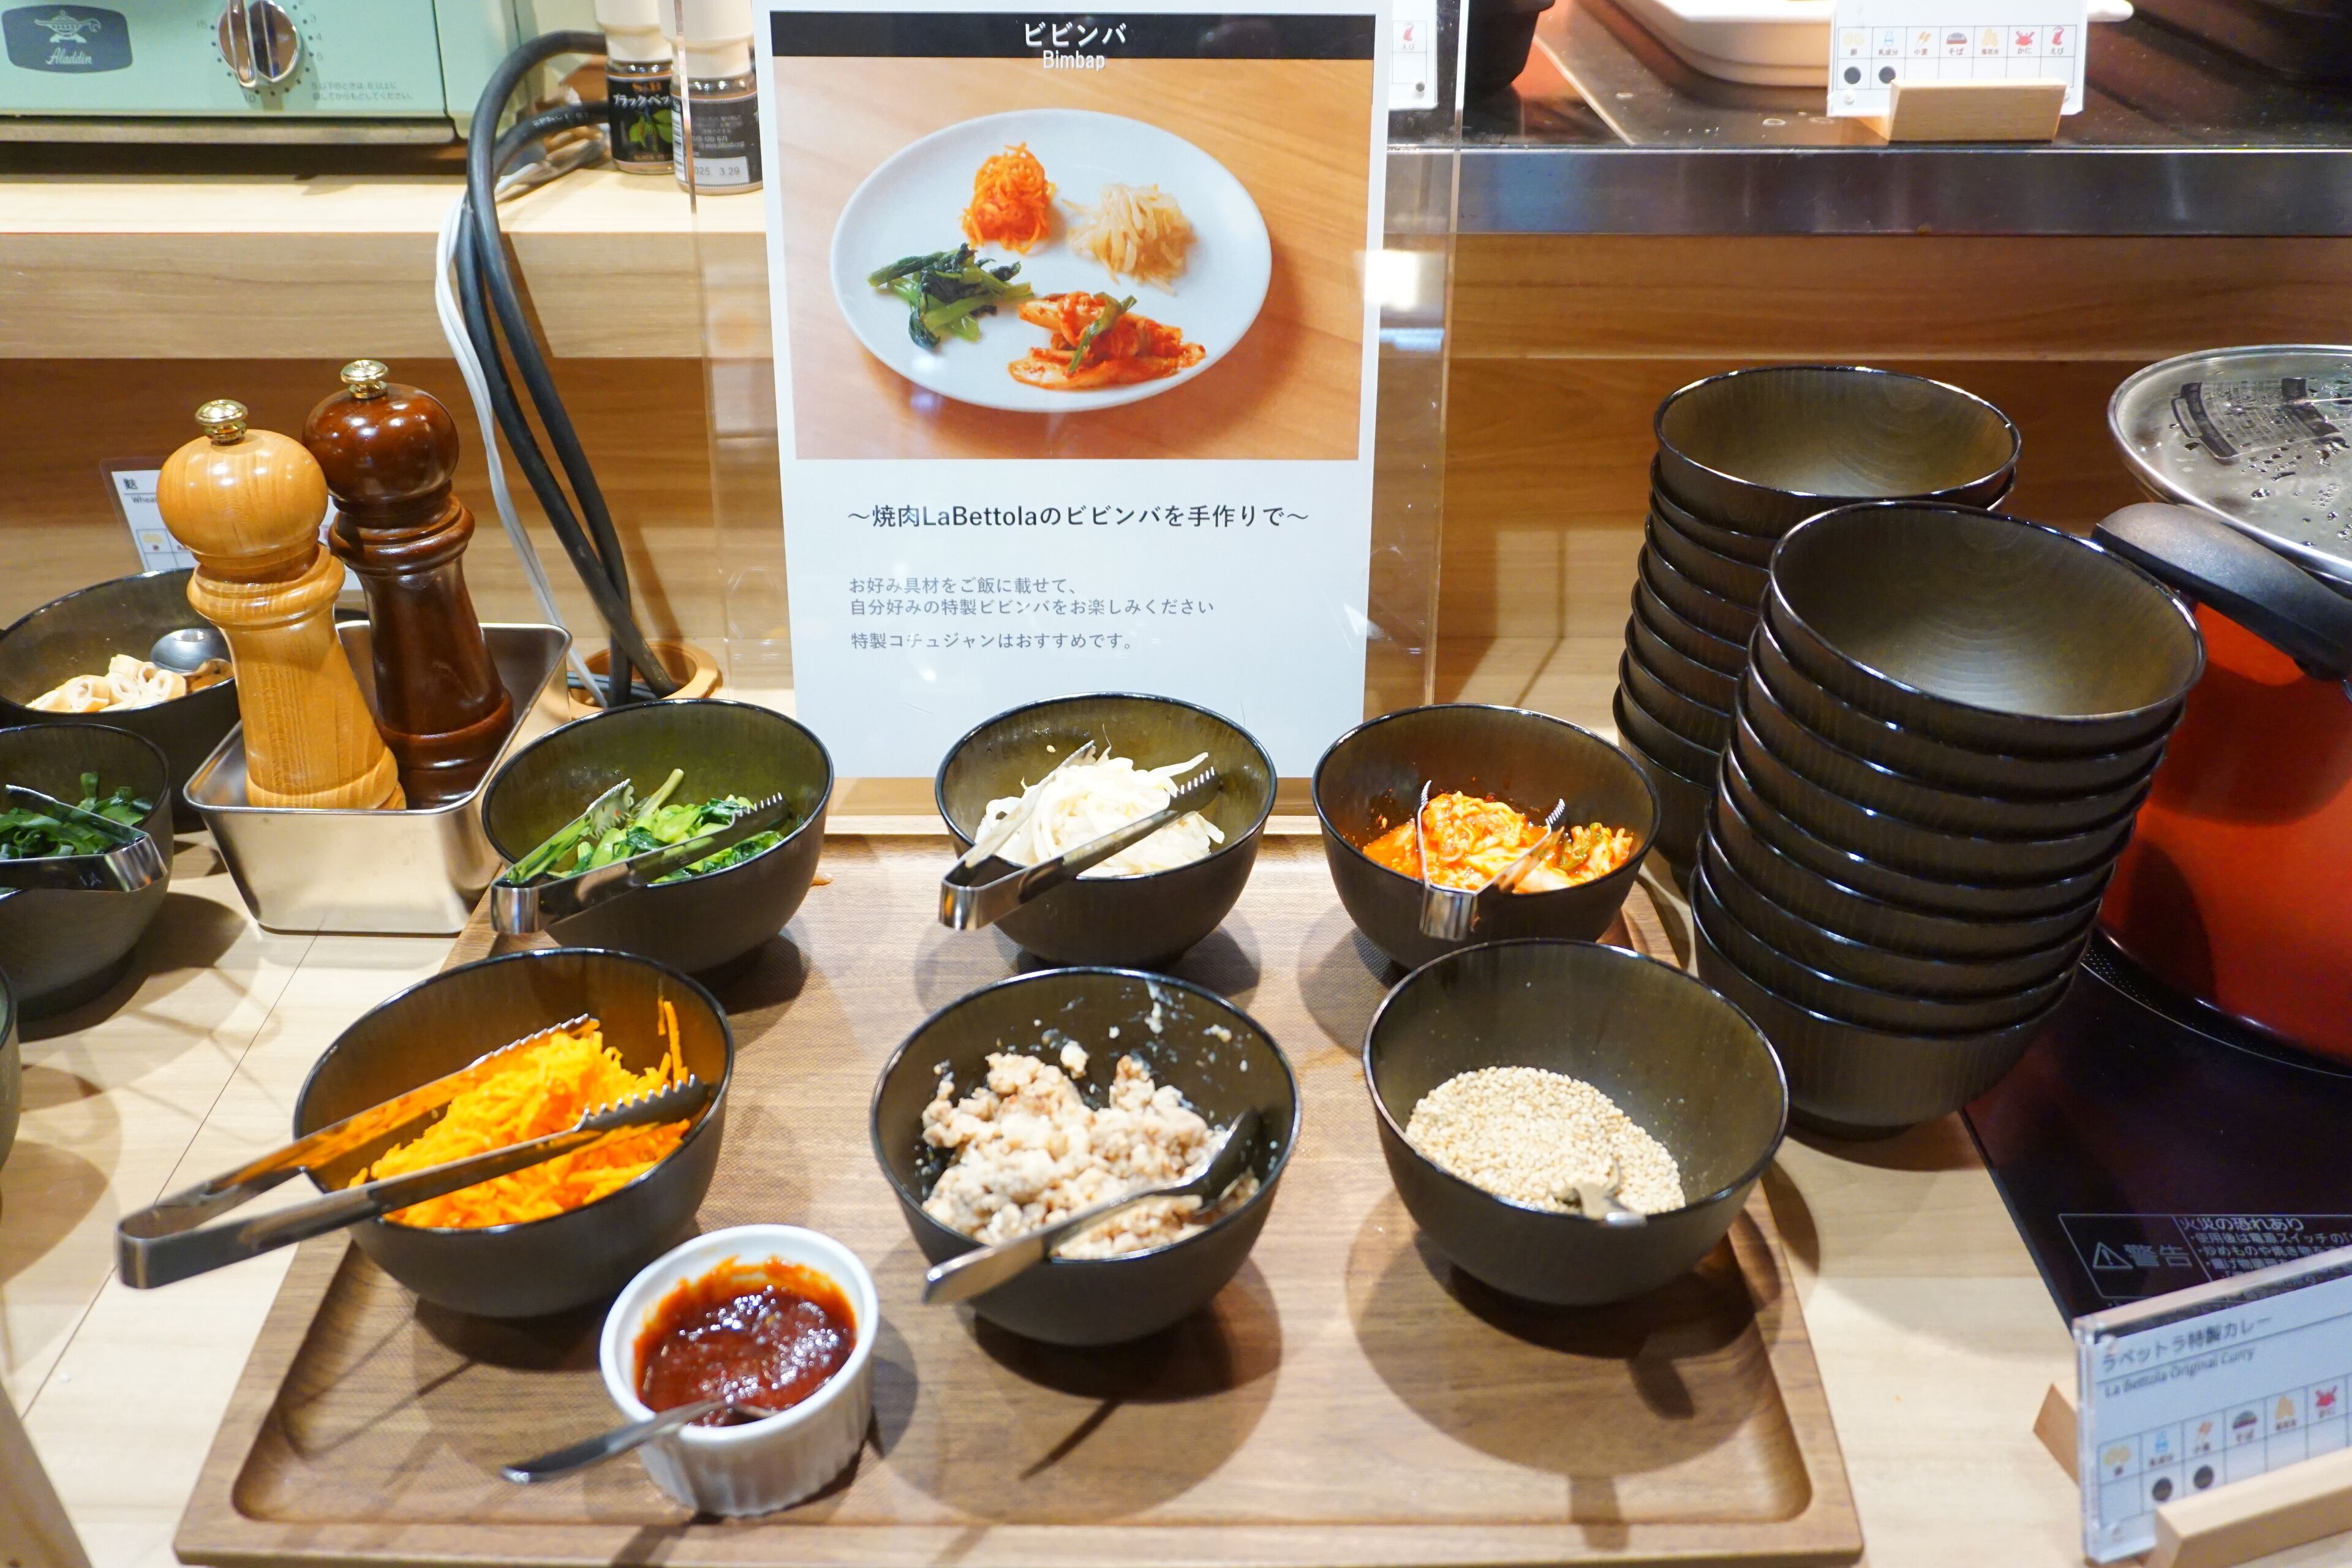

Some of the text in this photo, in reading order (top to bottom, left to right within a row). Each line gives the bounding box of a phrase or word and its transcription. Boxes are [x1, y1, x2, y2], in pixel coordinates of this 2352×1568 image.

[1025, 21, 1127, 48] ビビンバ
[46, 47, 92, 65] Aladdin
[1948, 47, 1964, 56] そば
[2049, 47, 2065, 55] えび
[1042, 50, 1106, 71] Bimbap
[245, 93, 256, 103] 10
[849, 577, 1076, 594] お好み具材をご飯に載せて、
[851, 598, 1215, 616] 自分好みの特製ビビンバをお楽しみください
[851, 632, 1131, 649] 特製コチュジャンはおすすめです。
[2122, 1243, 2193, 1268] 警告
[2170, 1355, 2218, 1378] Original
[2222, 1347, 2255, 1365] Curry
